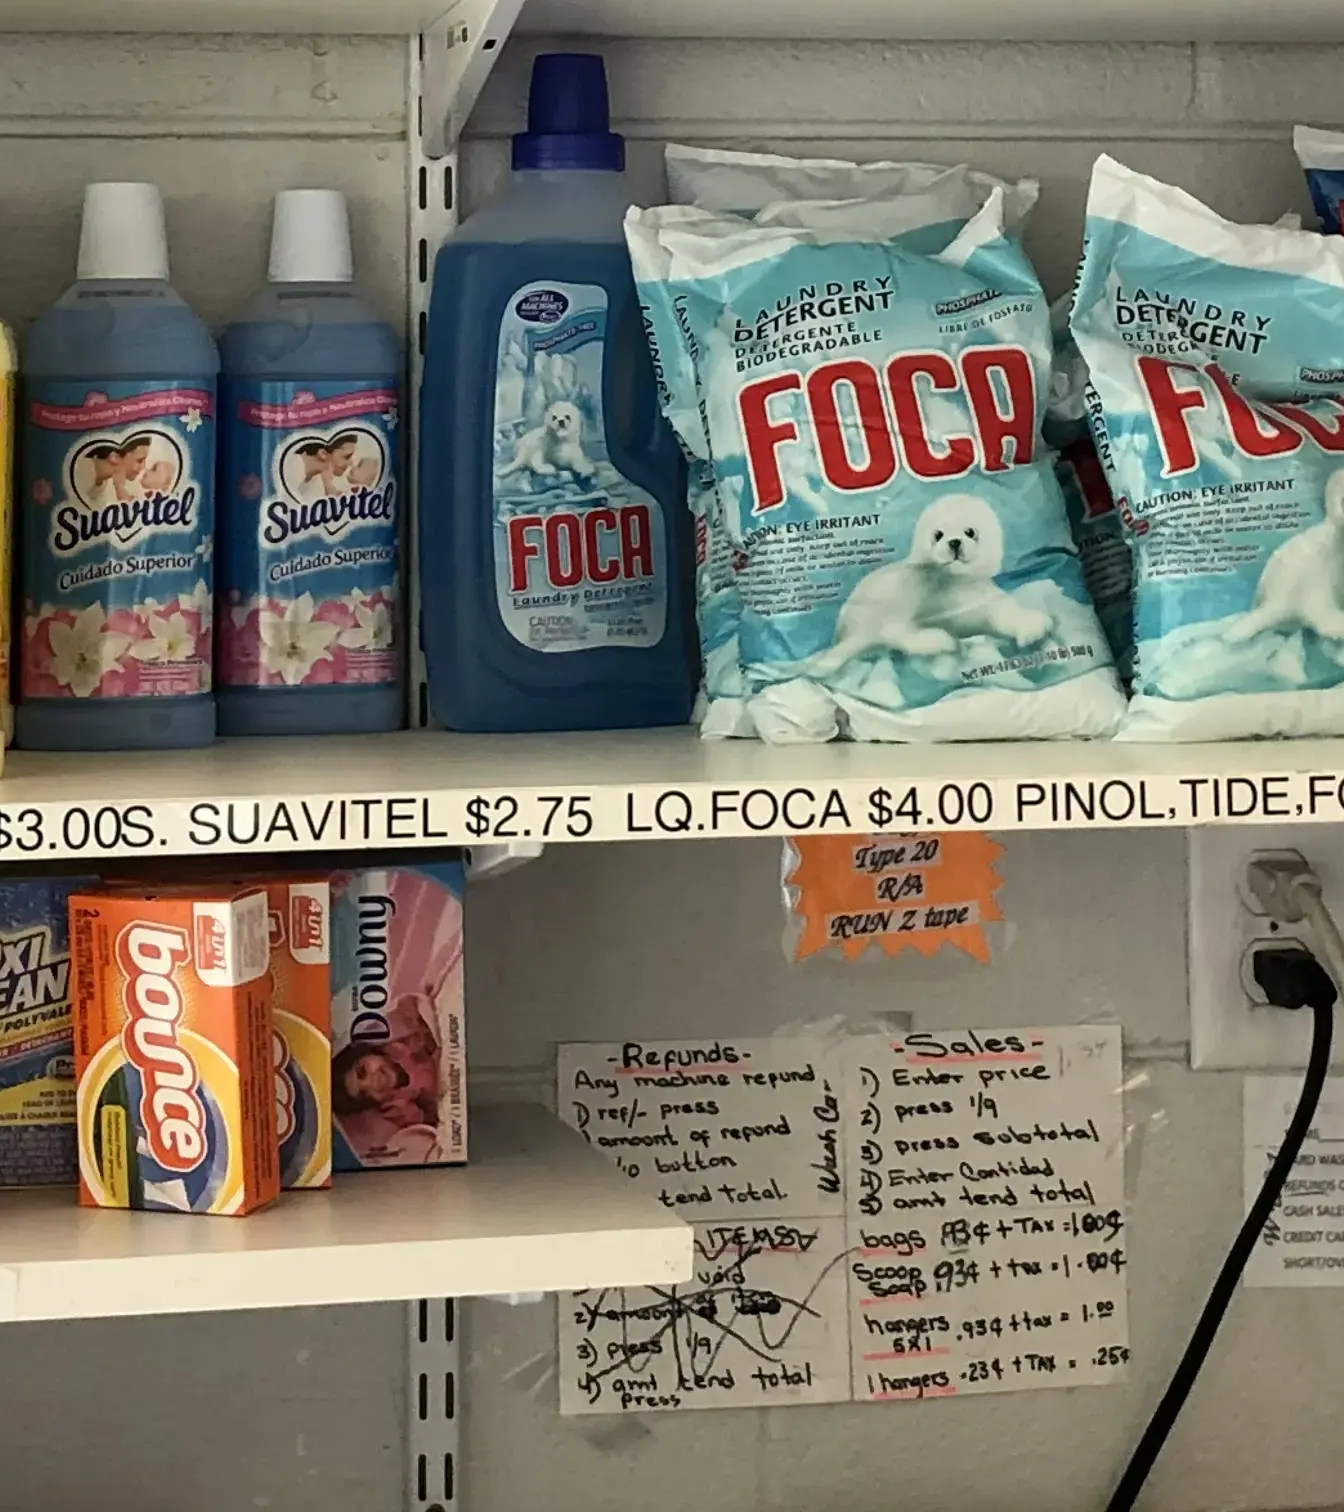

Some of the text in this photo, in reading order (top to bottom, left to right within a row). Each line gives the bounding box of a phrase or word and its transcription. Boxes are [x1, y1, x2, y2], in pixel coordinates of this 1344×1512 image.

[734, 291, 894, 343] DETERGENT
[735, 275, 892, 329] LAUNDRY
[736, 329, 883, 373] BIODEGRADABLE
[738, 345, 1035, 515] FOCA
[54, 486, 195, 550] Suavitel
[264, 484, 395, 544] Suavitel
[816, 514, 880, 531] IRRITANT
[509, 504, 654, 592] FOCA
[60, 555, 194, 590] Cuidado Superior
[189, 797, 447, 845] SUAVITEL
[465, 795, 592, 838] $2.75
[627, 788, 851, 832] LQ.FOCA
[868, 781, 993, 826] $4.00
[856, 839, 939, 873] Type 20
[831, 910, 892, 938] RUN
[924, 906, 969, 929] tape
[351, 893, 395, 1043] Downy
[127, 925, 204, 1161] bounce
[575, 1070, 730, 1098] Any machine
[893, 1064, 1050, 1088] Enter price
[660, 1101, 719, 1119] press
[895, 1100, 953, 1122] press
[973, 1119, 1100, 1145] subtotal
[655, 1151, 737, 1173] button
[959, 1179, 1095, 1206] tend total
[1283, 1206, 1313, 1217] CASH
[860, 1229, 926, 1256] bags
[1283, 1231, 1323, 1243] CREDIT
[864, 1314, 950, 1335] hangers
[752, 1362, 812, 1390] total
